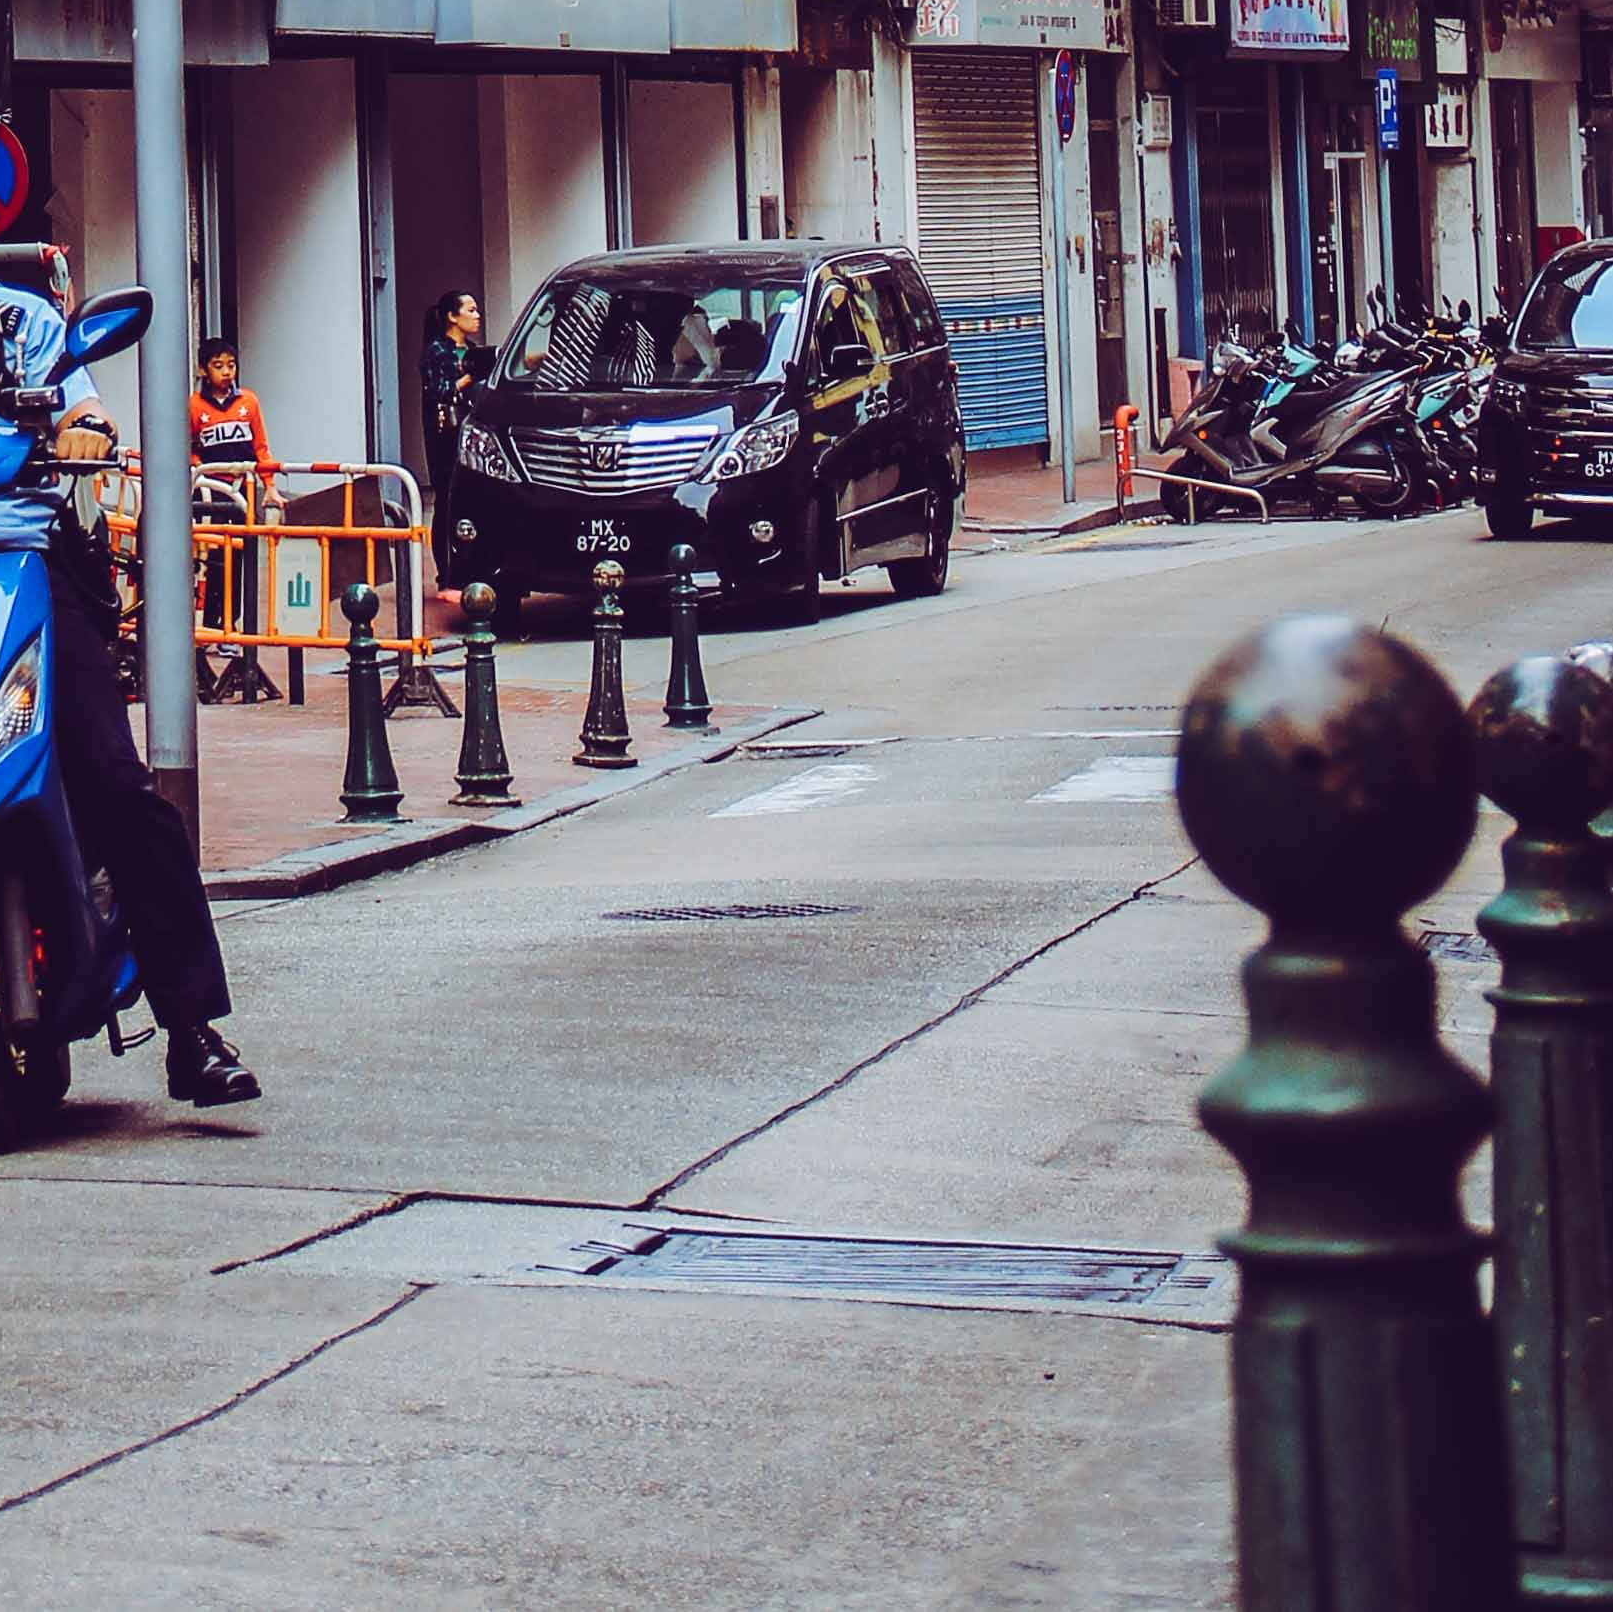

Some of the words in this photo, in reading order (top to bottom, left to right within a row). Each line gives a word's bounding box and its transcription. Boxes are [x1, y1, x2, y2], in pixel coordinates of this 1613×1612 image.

[202, 424, 246, 443] FILA
[1584, 462, 1613, 477] 63-
[591, 519, 614, 535] MX
[576, 535, 631, 552] 87-20
